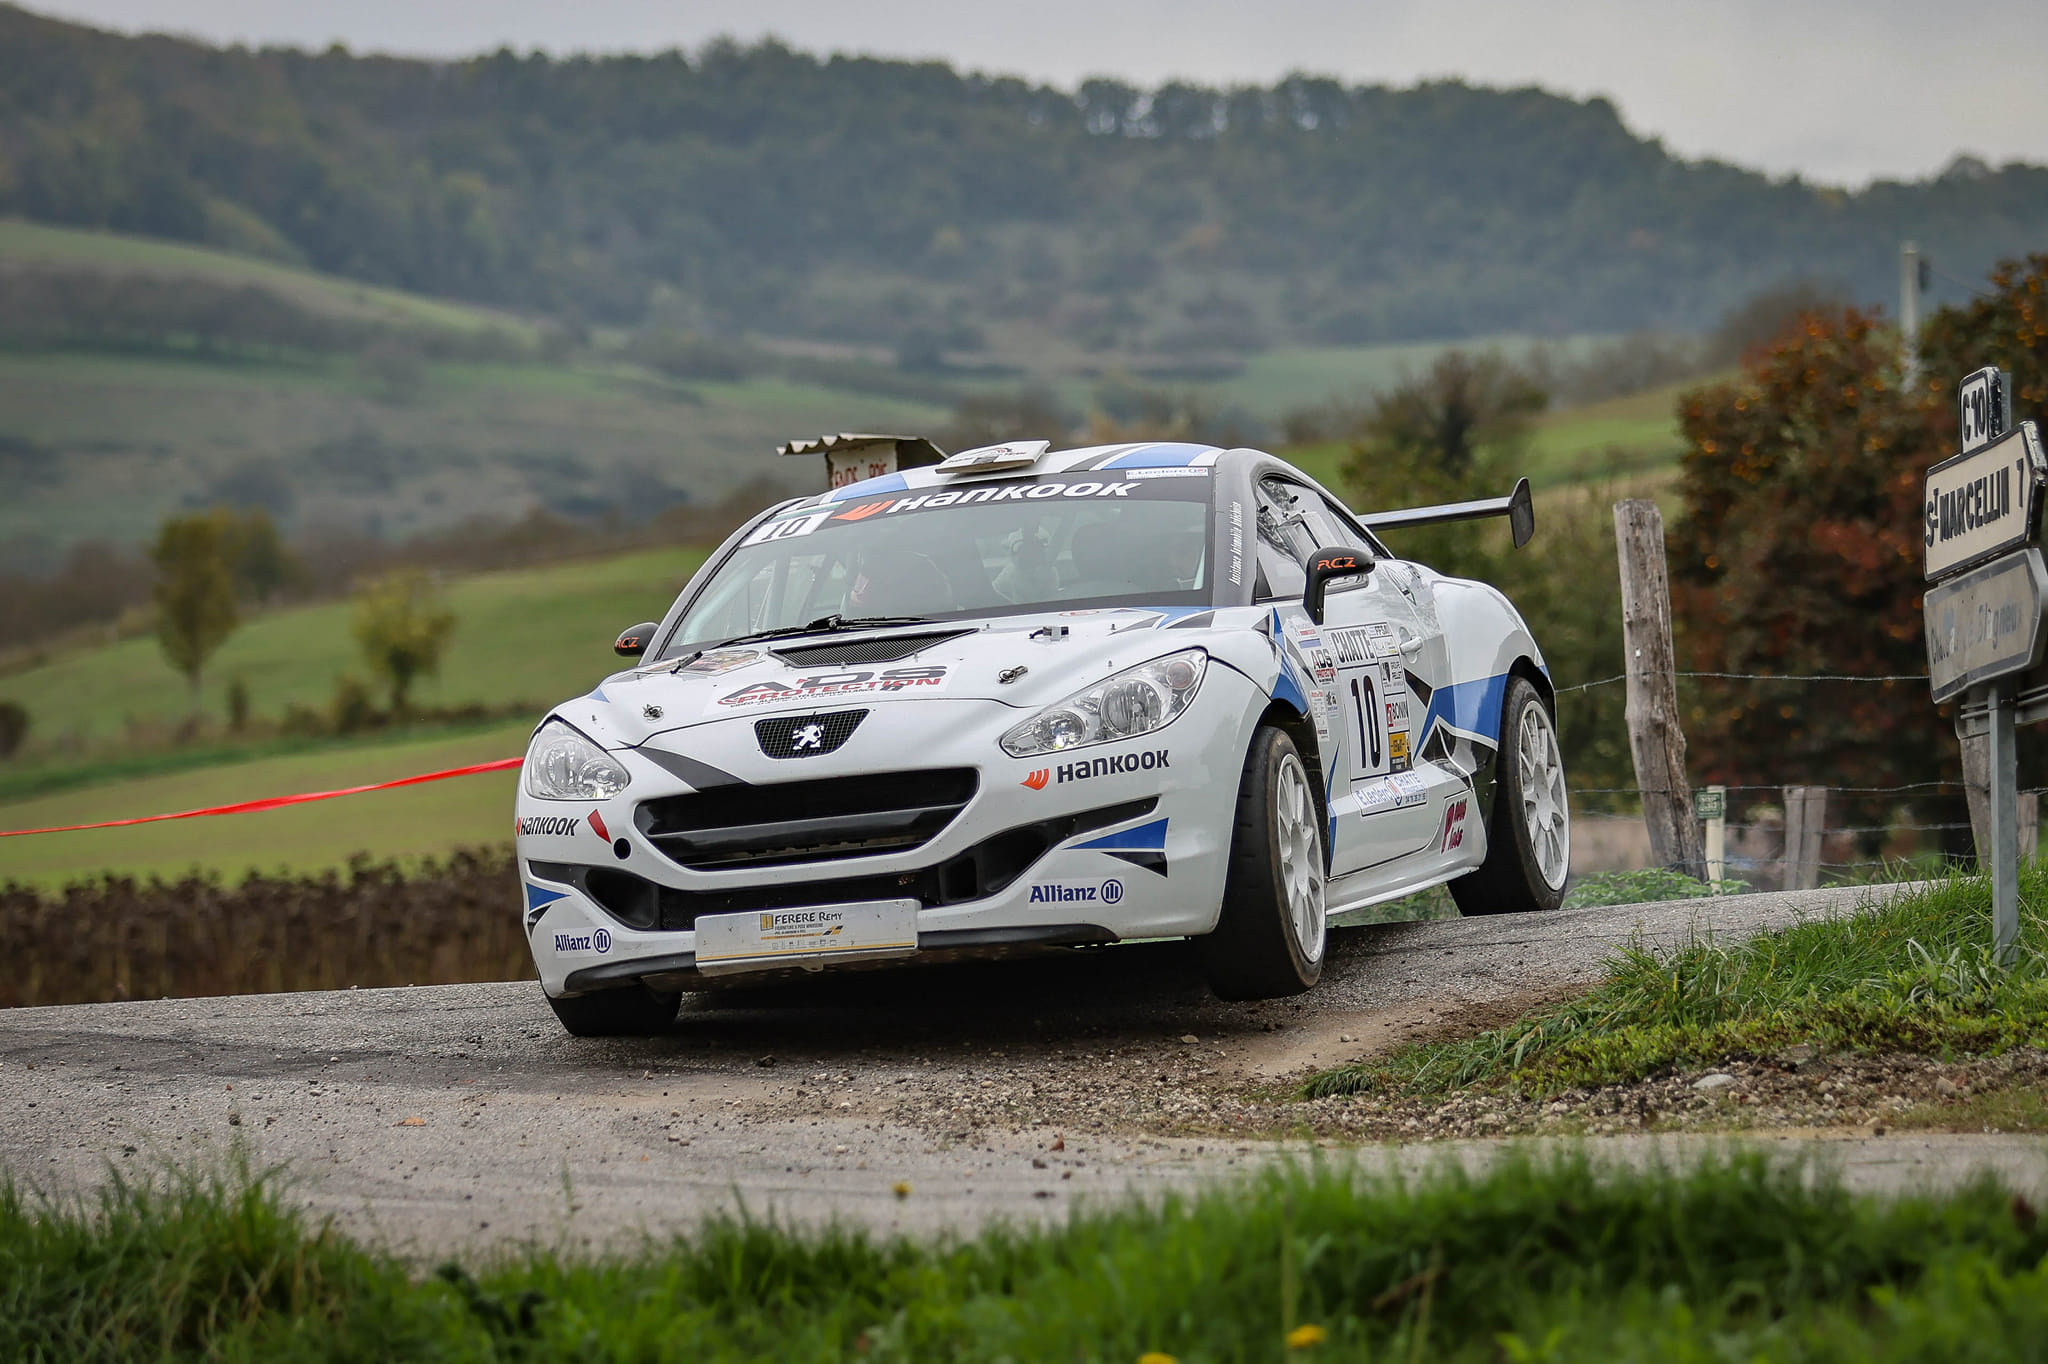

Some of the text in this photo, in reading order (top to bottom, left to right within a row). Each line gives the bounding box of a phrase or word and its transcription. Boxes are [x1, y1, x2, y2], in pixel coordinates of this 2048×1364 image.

[1939, 466, 2010, 542] MARCELLIN
[2016, 457, 2024, 508] 7
[760, 517, 812, 541] 10
[1316, 557, 1356, 571] RCZ
[1330, 629, 1375, 663] CHATTE
[1310, 648, 1333, 670] ADS
[718, 666, 947, 703] ADS
[737, 678, 941, 704] PROTECTION
[1350, 675, 1381, 769] 10
[1029, 885, 1096, 903] Allianz
[775, 913, 816, 925] FERERE
[554, 934, 591, 951] Allianz
